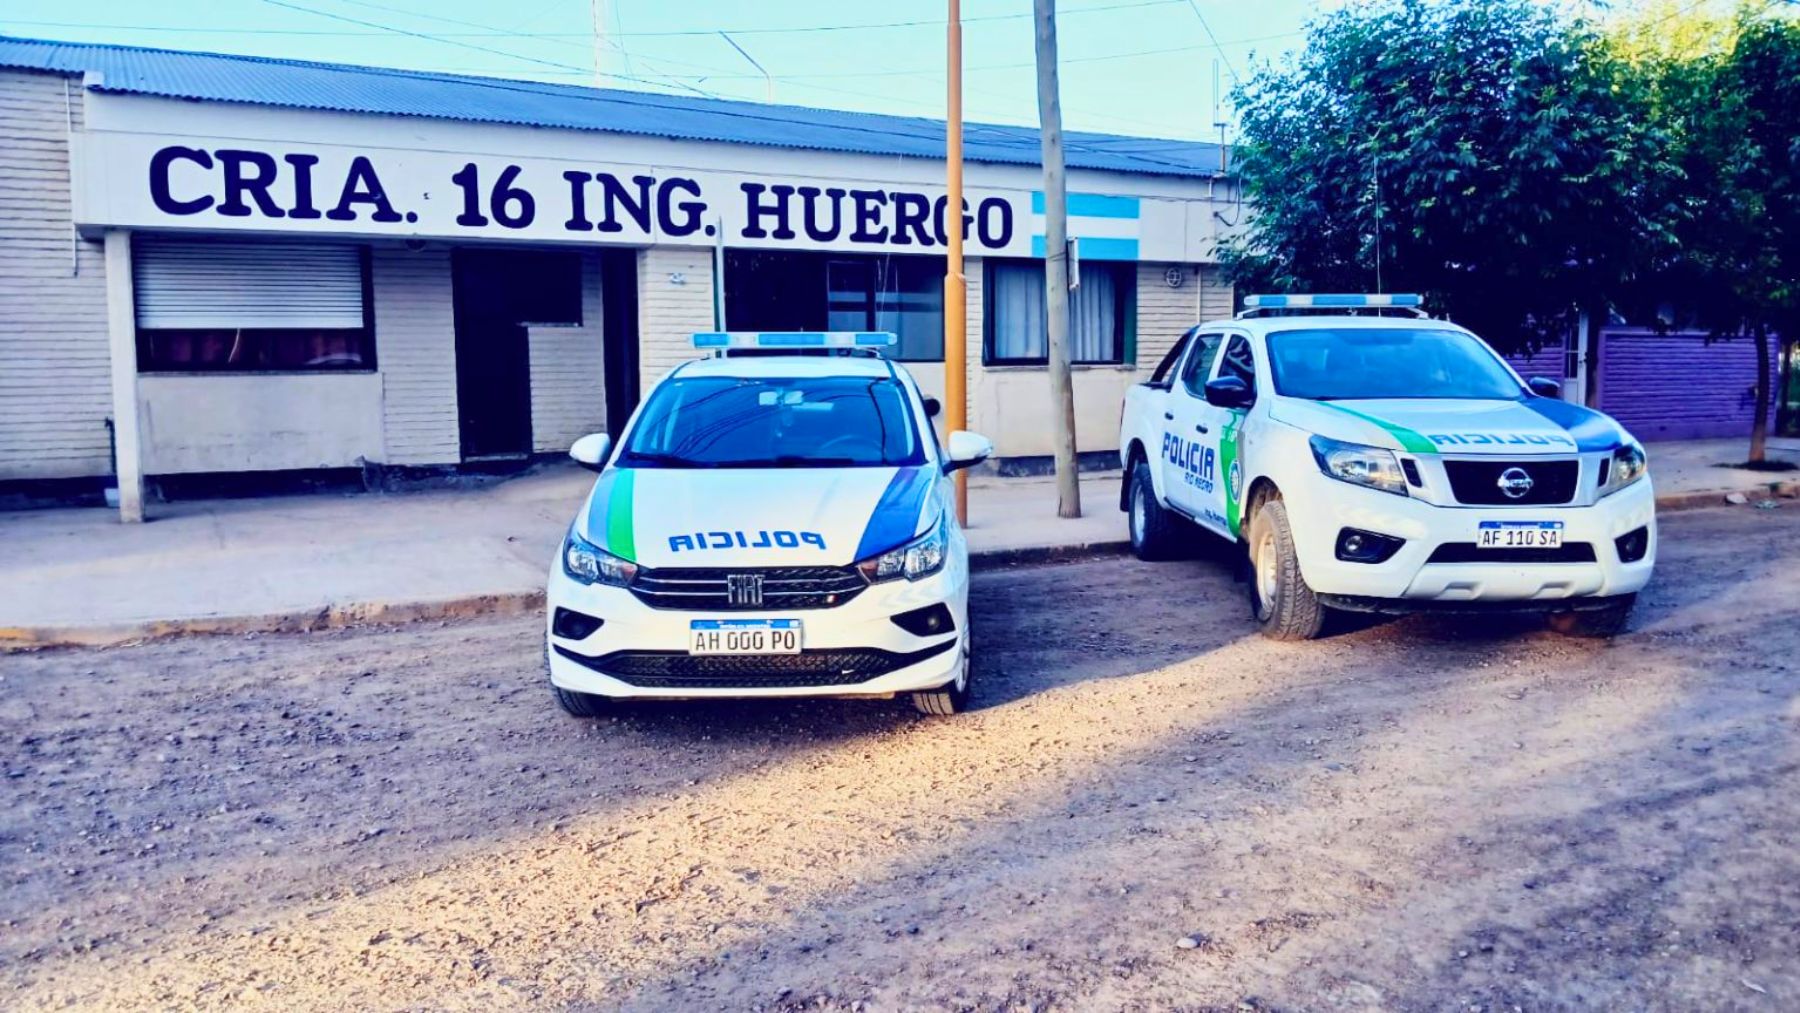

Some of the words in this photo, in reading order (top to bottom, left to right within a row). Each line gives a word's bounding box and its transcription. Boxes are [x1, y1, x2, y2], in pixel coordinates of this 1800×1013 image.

[149, 145, 418, 223] CRIA.
[451, 162, 536, 229] 16
[562, 170, 716, 237] ING.
[740, 182, 1014, 249] HUERGO
[1161, 432, 1215, 481] POLICIA
[1482, 530, 1501, 545] AF
[1506, 530, 1534, 545] 110
[1539, 530, 1557, 545] SA
[727, 574, 765, 605] FIAT
[695, 631, 720, 651] AH
[727, 631, 763, 650] 000
[772, 630, 795, 650] PO
